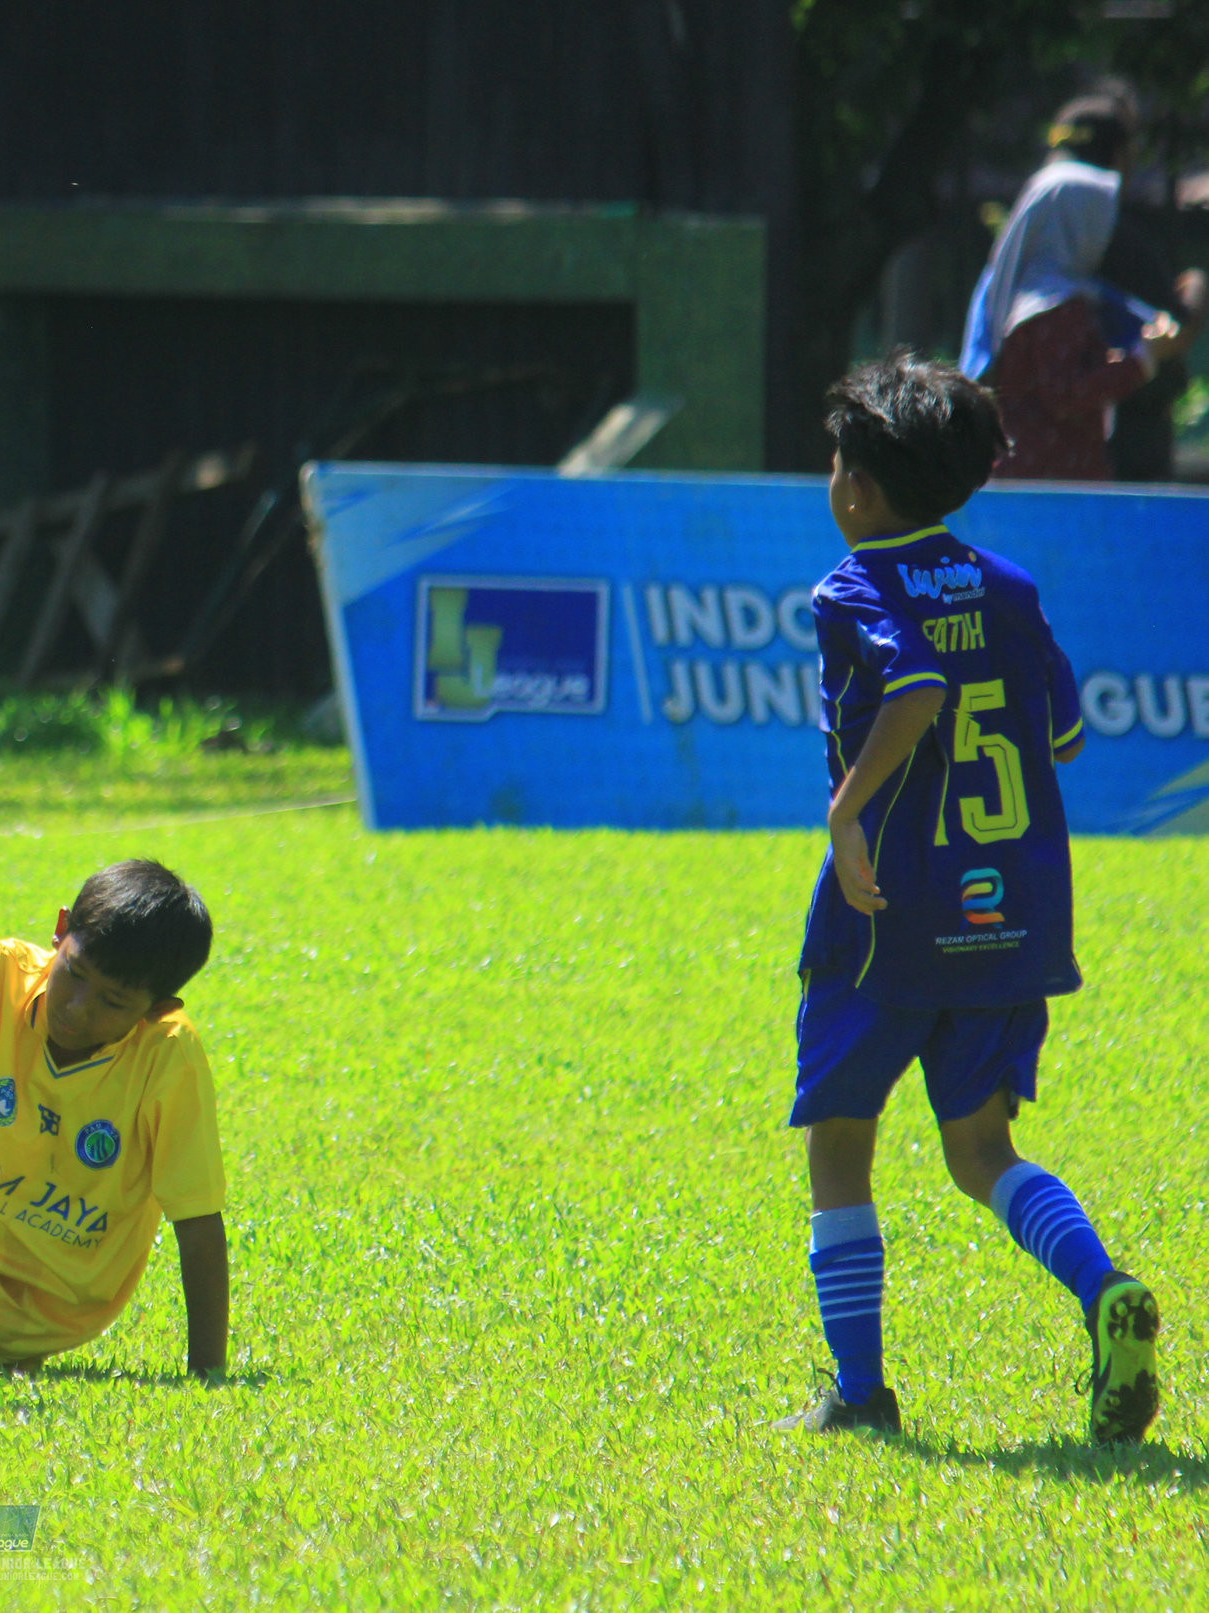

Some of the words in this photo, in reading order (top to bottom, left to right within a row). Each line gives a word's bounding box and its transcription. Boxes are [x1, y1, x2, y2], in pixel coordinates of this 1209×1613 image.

[935, 935, 964, 945] REZAM
[965, 932, 998, 943] OPTICAL
[999, 929, 1028, 940] GROUP
[30, 1182, 108, 1233] JAYA
[15, 1209, 103, 1249] ACADEMY
